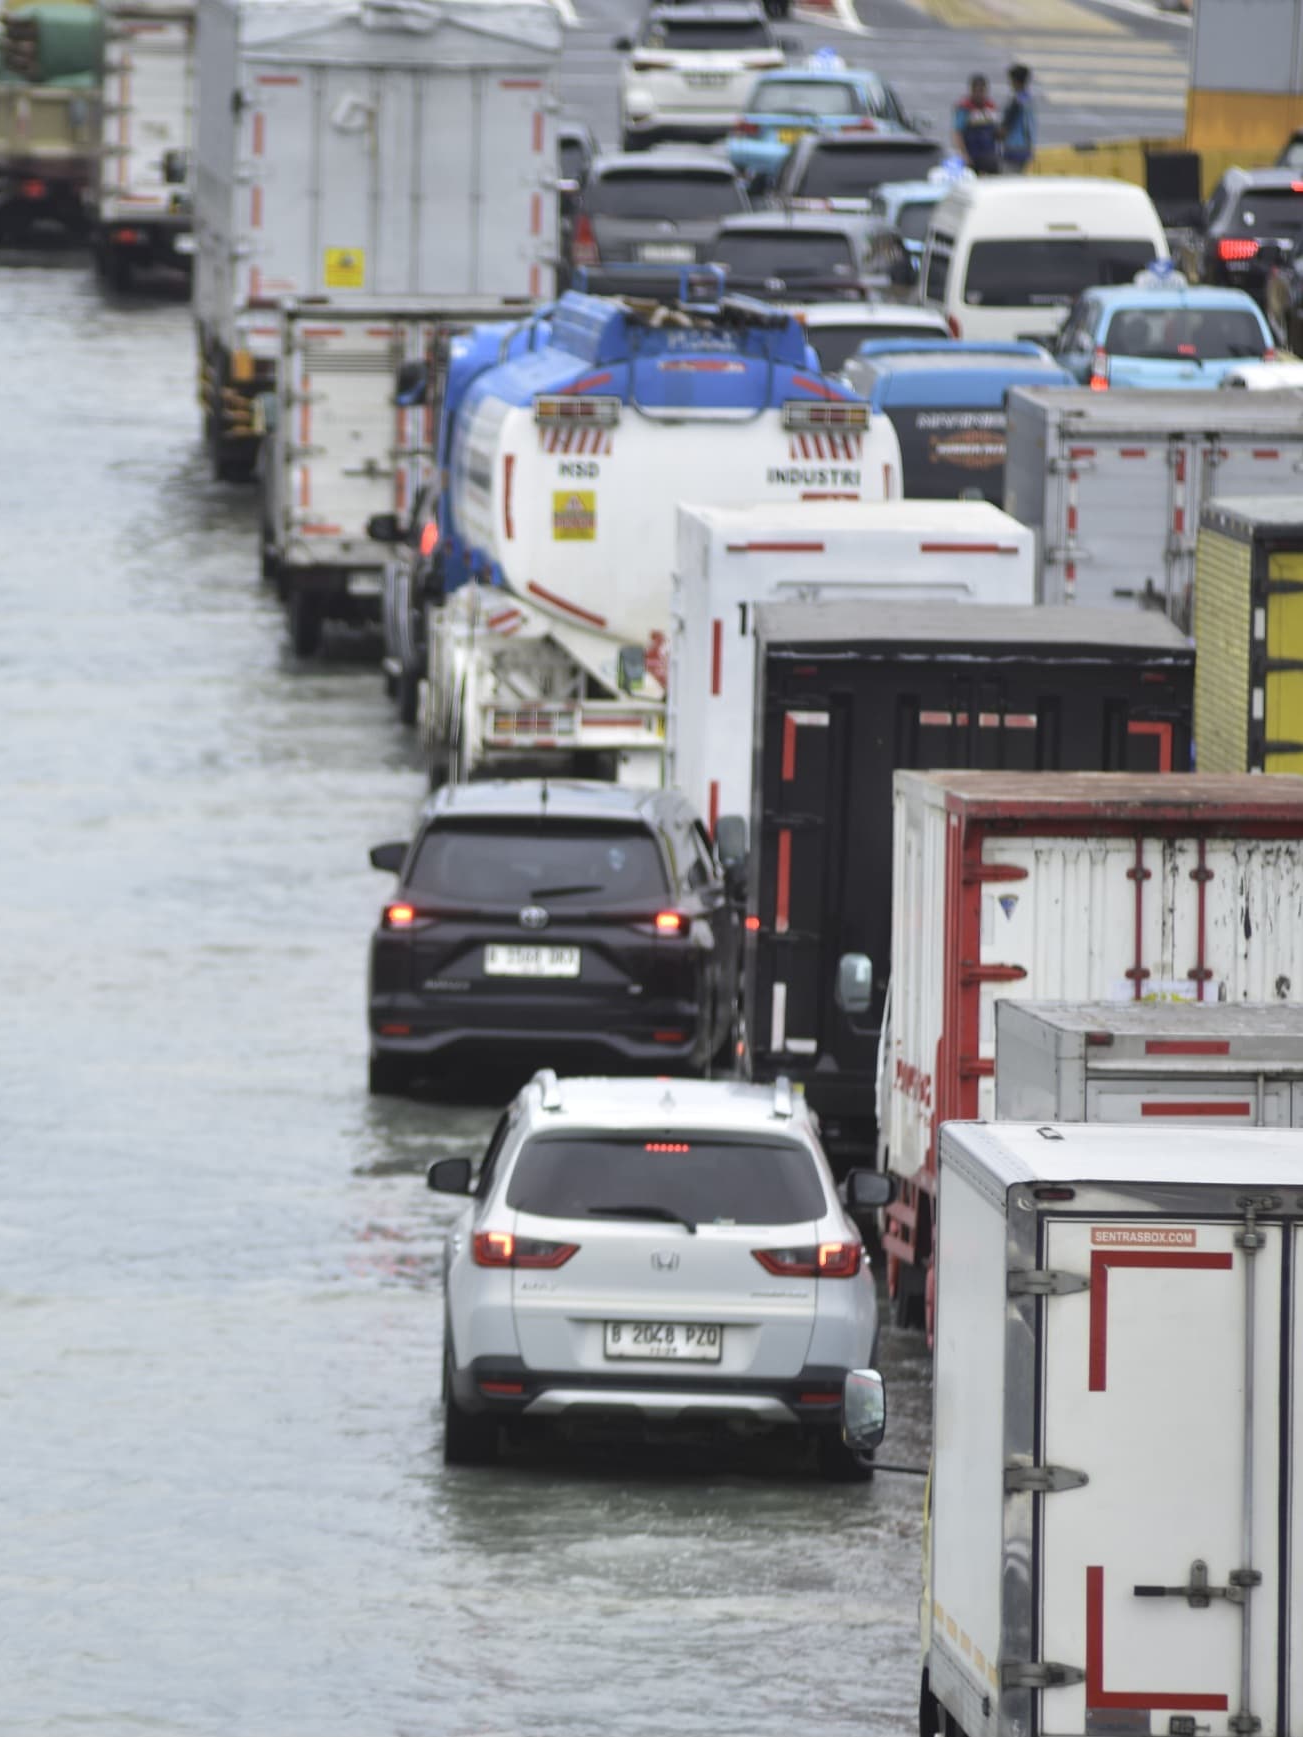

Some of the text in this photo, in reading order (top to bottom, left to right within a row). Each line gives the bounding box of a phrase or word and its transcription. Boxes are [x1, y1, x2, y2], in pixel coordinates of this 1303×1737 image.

[766, 467, 861, 488] INDUSTRI
[1095, 1231, 1193, 1243] SENTRASBOX.COM
[611, 1325, 622, 1344] B
[633, 1324, 675, 1345] 2048
